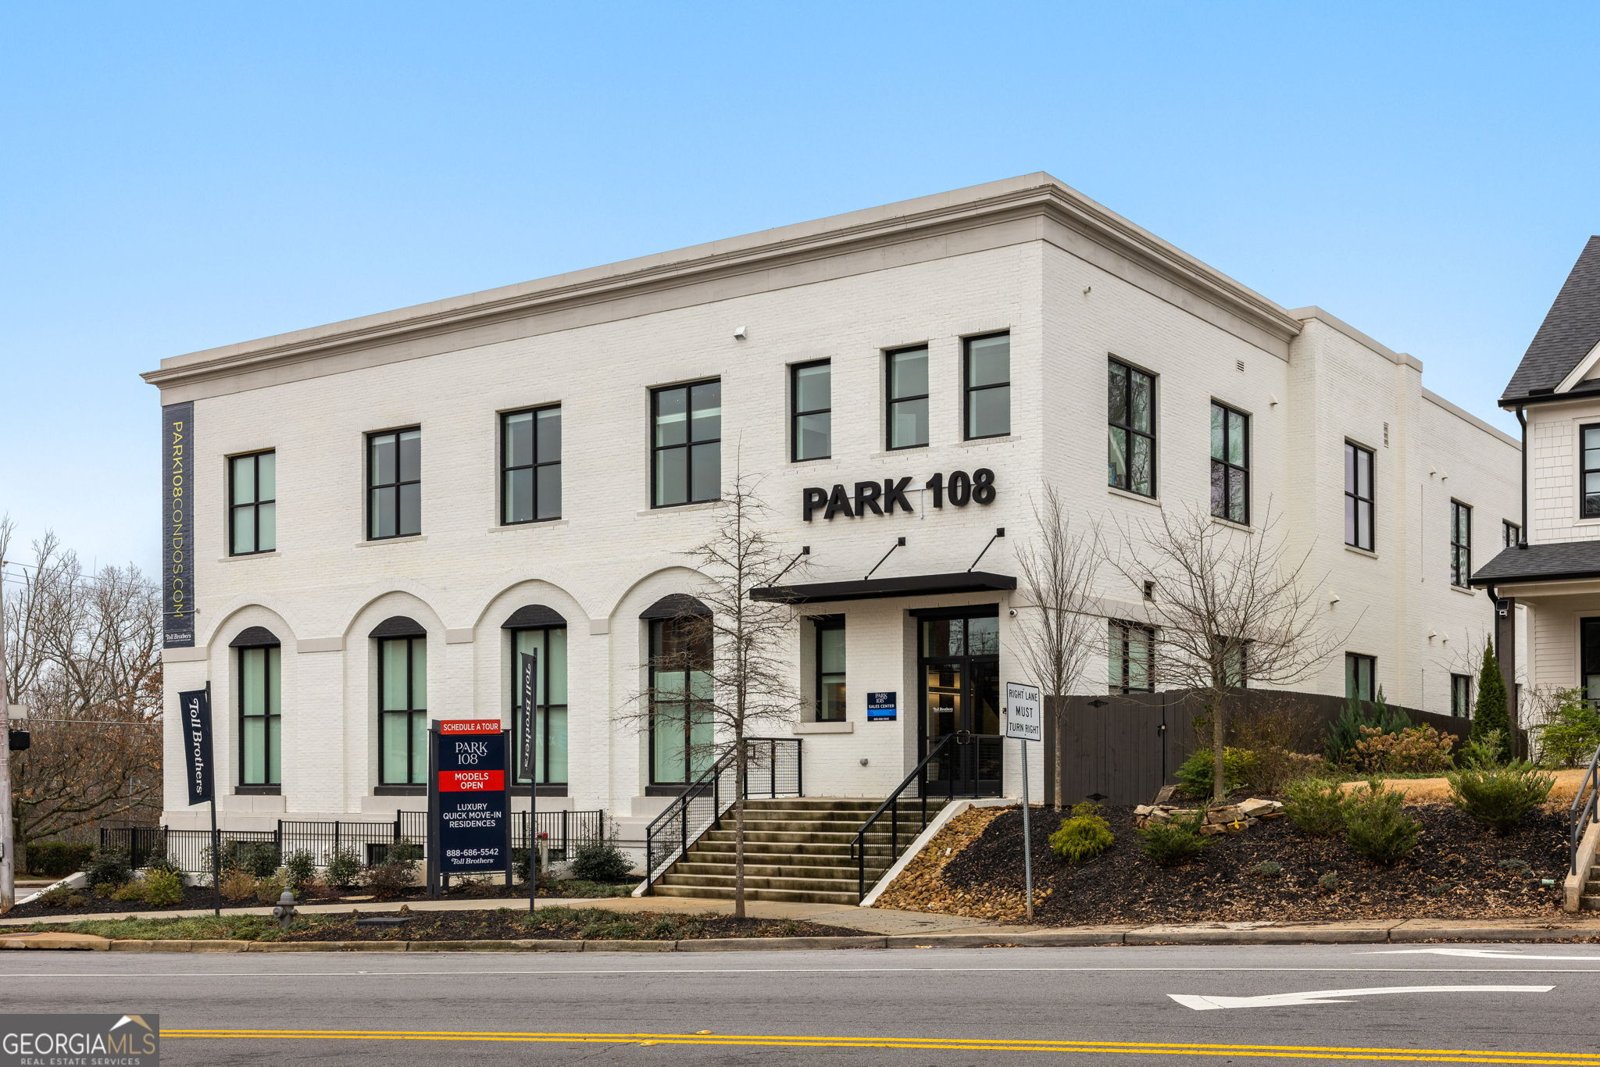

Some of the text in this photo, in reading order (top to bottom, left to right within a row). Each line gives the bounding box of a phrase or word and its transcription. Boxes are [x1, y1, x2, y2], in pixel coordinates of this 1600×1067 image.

[802, 467, 997, 522] PARK 108
[173, 421, 183, 617] PARK108CONDOS.COM
[1009, 689, 1038, 702] RIGHT LANE
[1015, 705, 1033, 718] MUST
[443, 723, 475, 731] SCHEDULE
[482, 722, 499, 730] TOUR
[524, 697, 532, 768] Brothers
[1009, 722, 1039, 735] TURN RIGHT
[189, 698, 204, 794] Toll Brothers
[455, 741, 488, 757] PARK
[458, 753, 478, 765] 108
[454, 772, 489, 781] MODELS
[460, 781, 484, 789] OPEN
[457, 803, 488, 811] LUXURY
[442, 811, 502, 820] QUICK MOVE-IN
[449, 820, 496, 828] RESIDENCES
[446, 848, 499, 857] 888-686-5542
[451, 857, 494, 865] Toll Brothers
